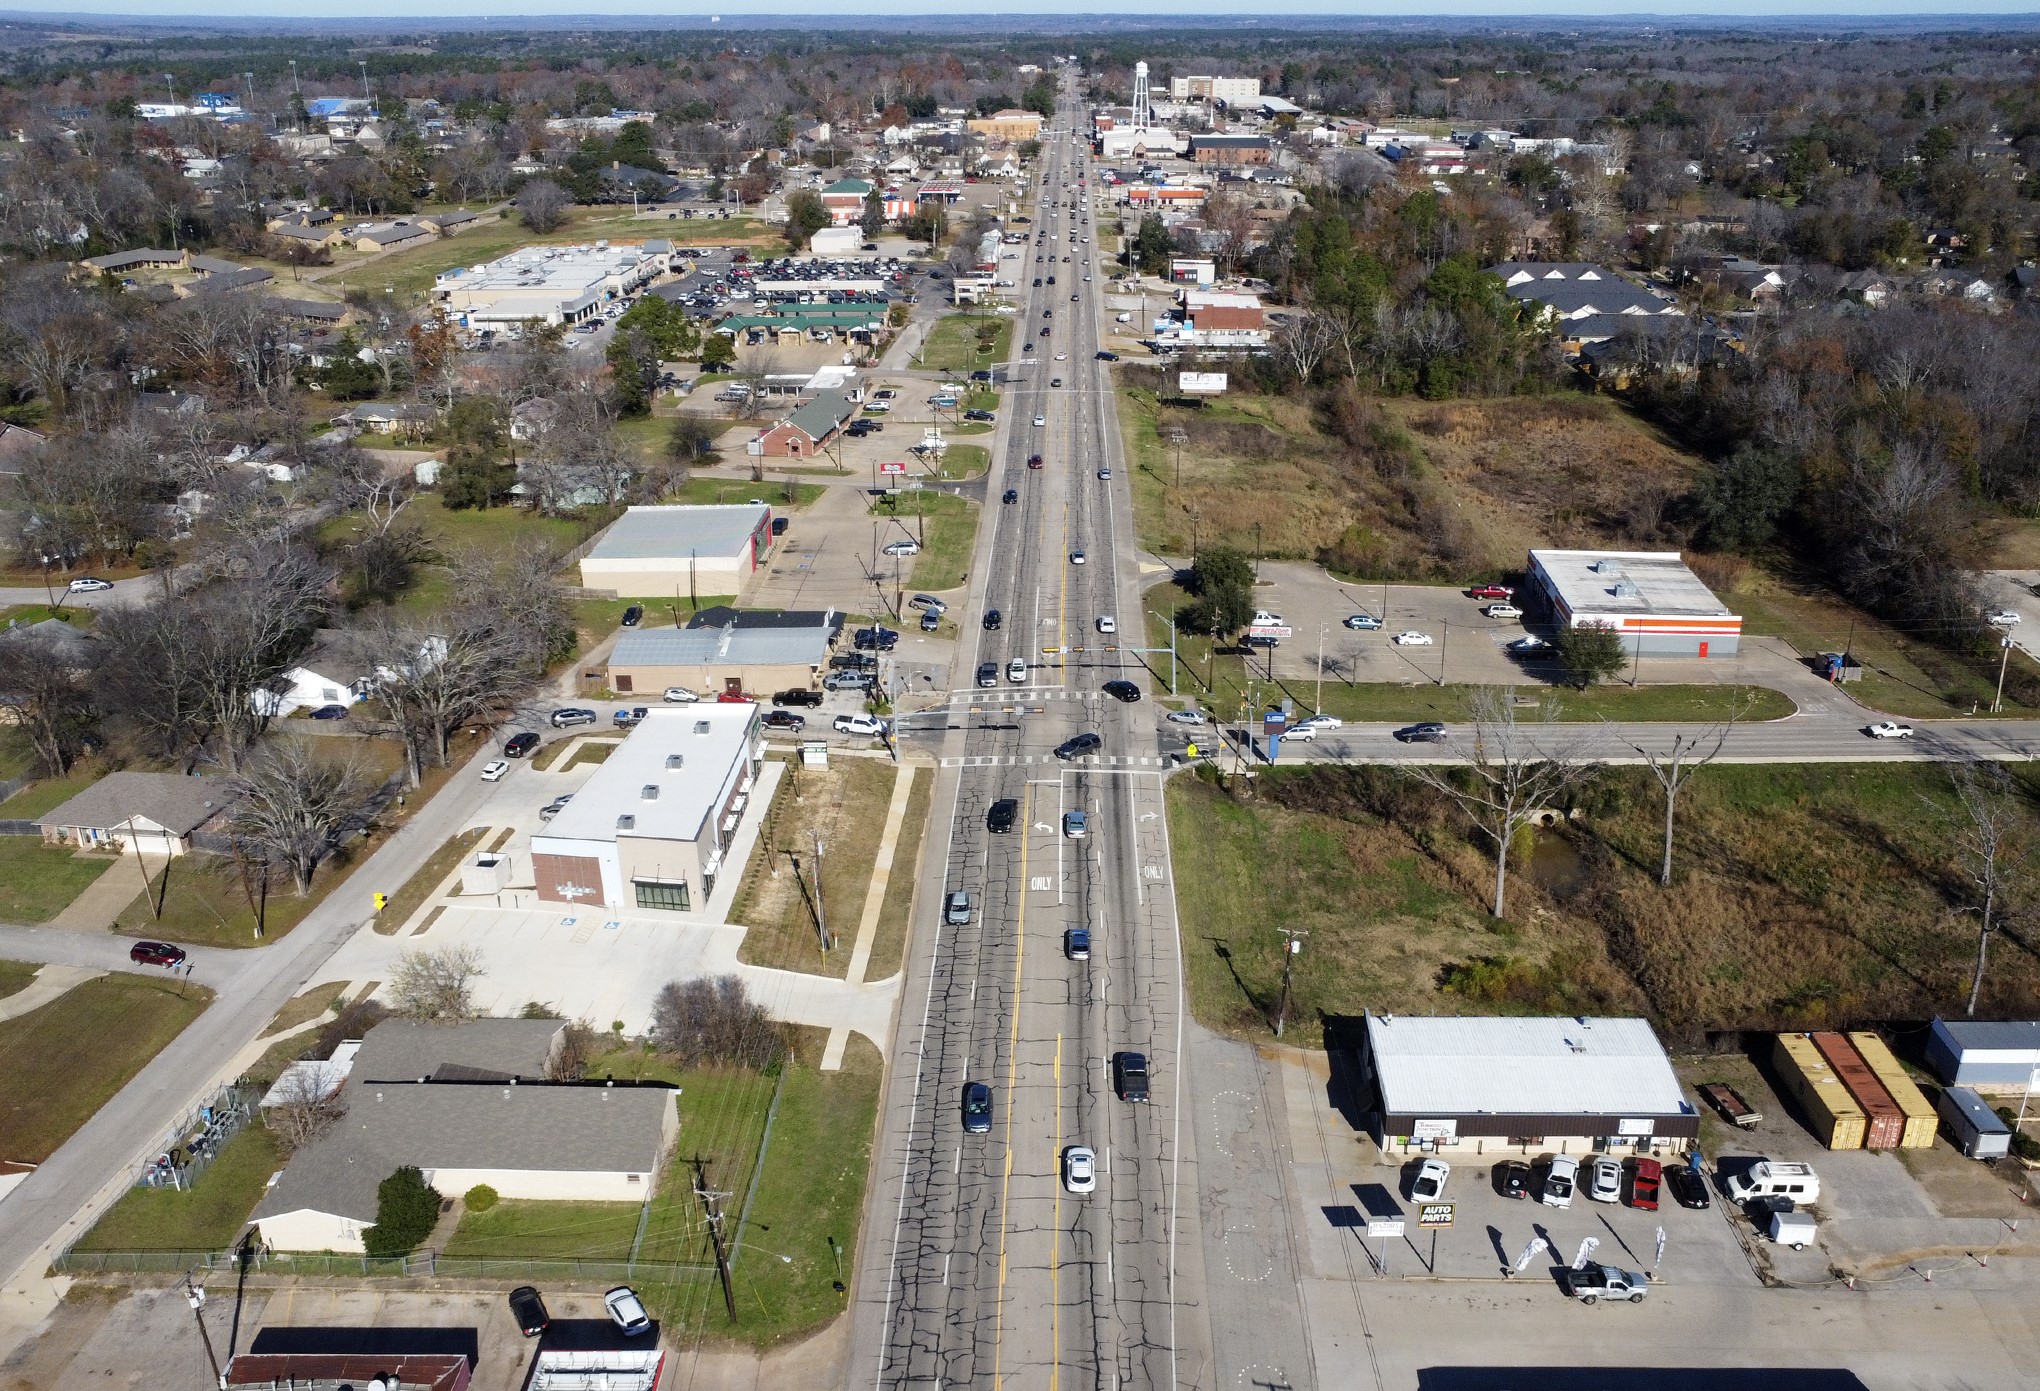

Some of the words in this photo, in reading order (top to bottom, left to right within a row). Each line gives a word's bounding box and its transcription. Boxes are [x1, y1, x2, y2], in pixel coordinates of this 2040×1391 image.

[1144, 865, 1164, 879] ONLY
[1031, 877, 1052, 890] ONLY
[1424, 1206, 1452, 1214] AUTO
[1421, 1214, 1452, 1222] PARTS
